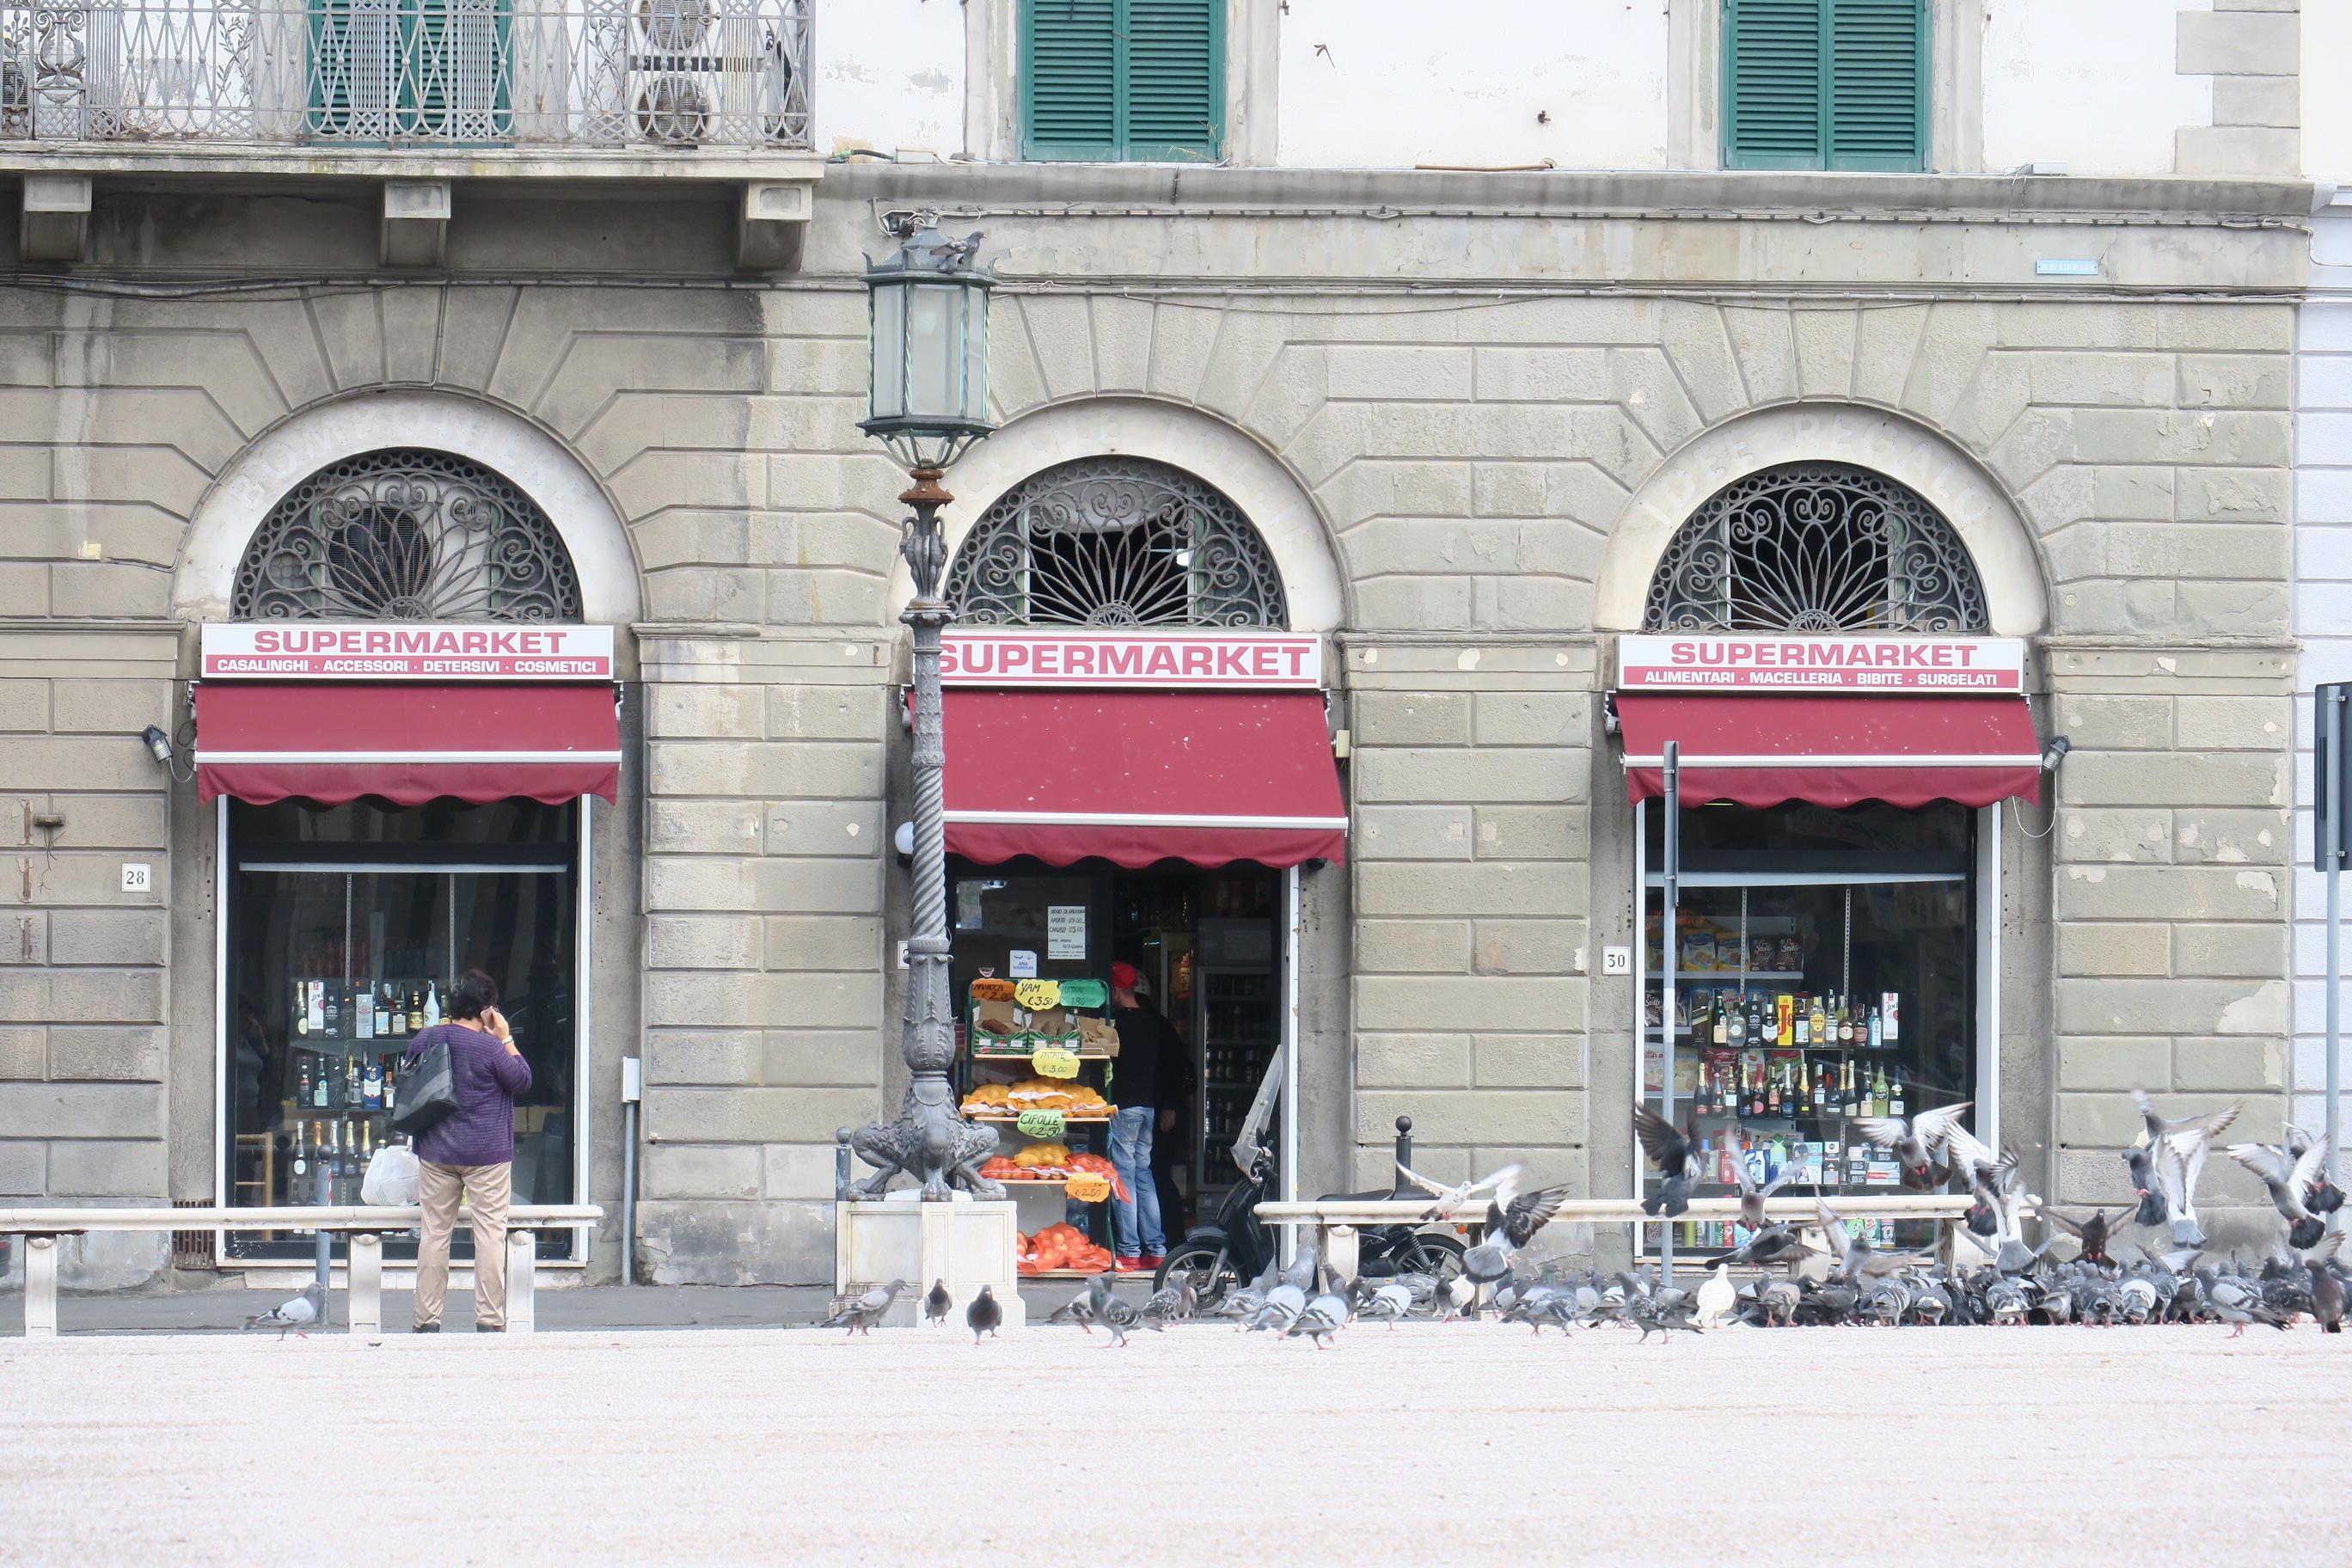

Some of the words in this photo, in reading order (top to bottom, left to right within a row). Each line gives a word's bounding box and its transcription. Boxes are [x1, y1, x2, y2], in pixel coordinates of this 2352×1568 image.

[254, 630, 567, 654] SUPERMARKET
[1671, 642, 1978, 666] SUPERMARKET
[217, 658, 309, 672] CASALINGHI
[323, 659, 408, 673] ACCESSORI
[423, 660, 499, 673] DETERSIVI
[514, 660, 597, 673] COSMETICI
[1645, 671, 1736, 683] ALIMENTARI
[1749, 671, 1843, 684] MACELLERIA
[1857, 673, 1902, 685] BIBITE
[1917, 673, 1998, 686] SURGELATI
[126, 871, 144, 885] 28
[1608, 953, 1626, 968] 30
[1020, 983, 1041, 995] YAM
[1020, 1114, 1060, 1125] CIPOLLE
